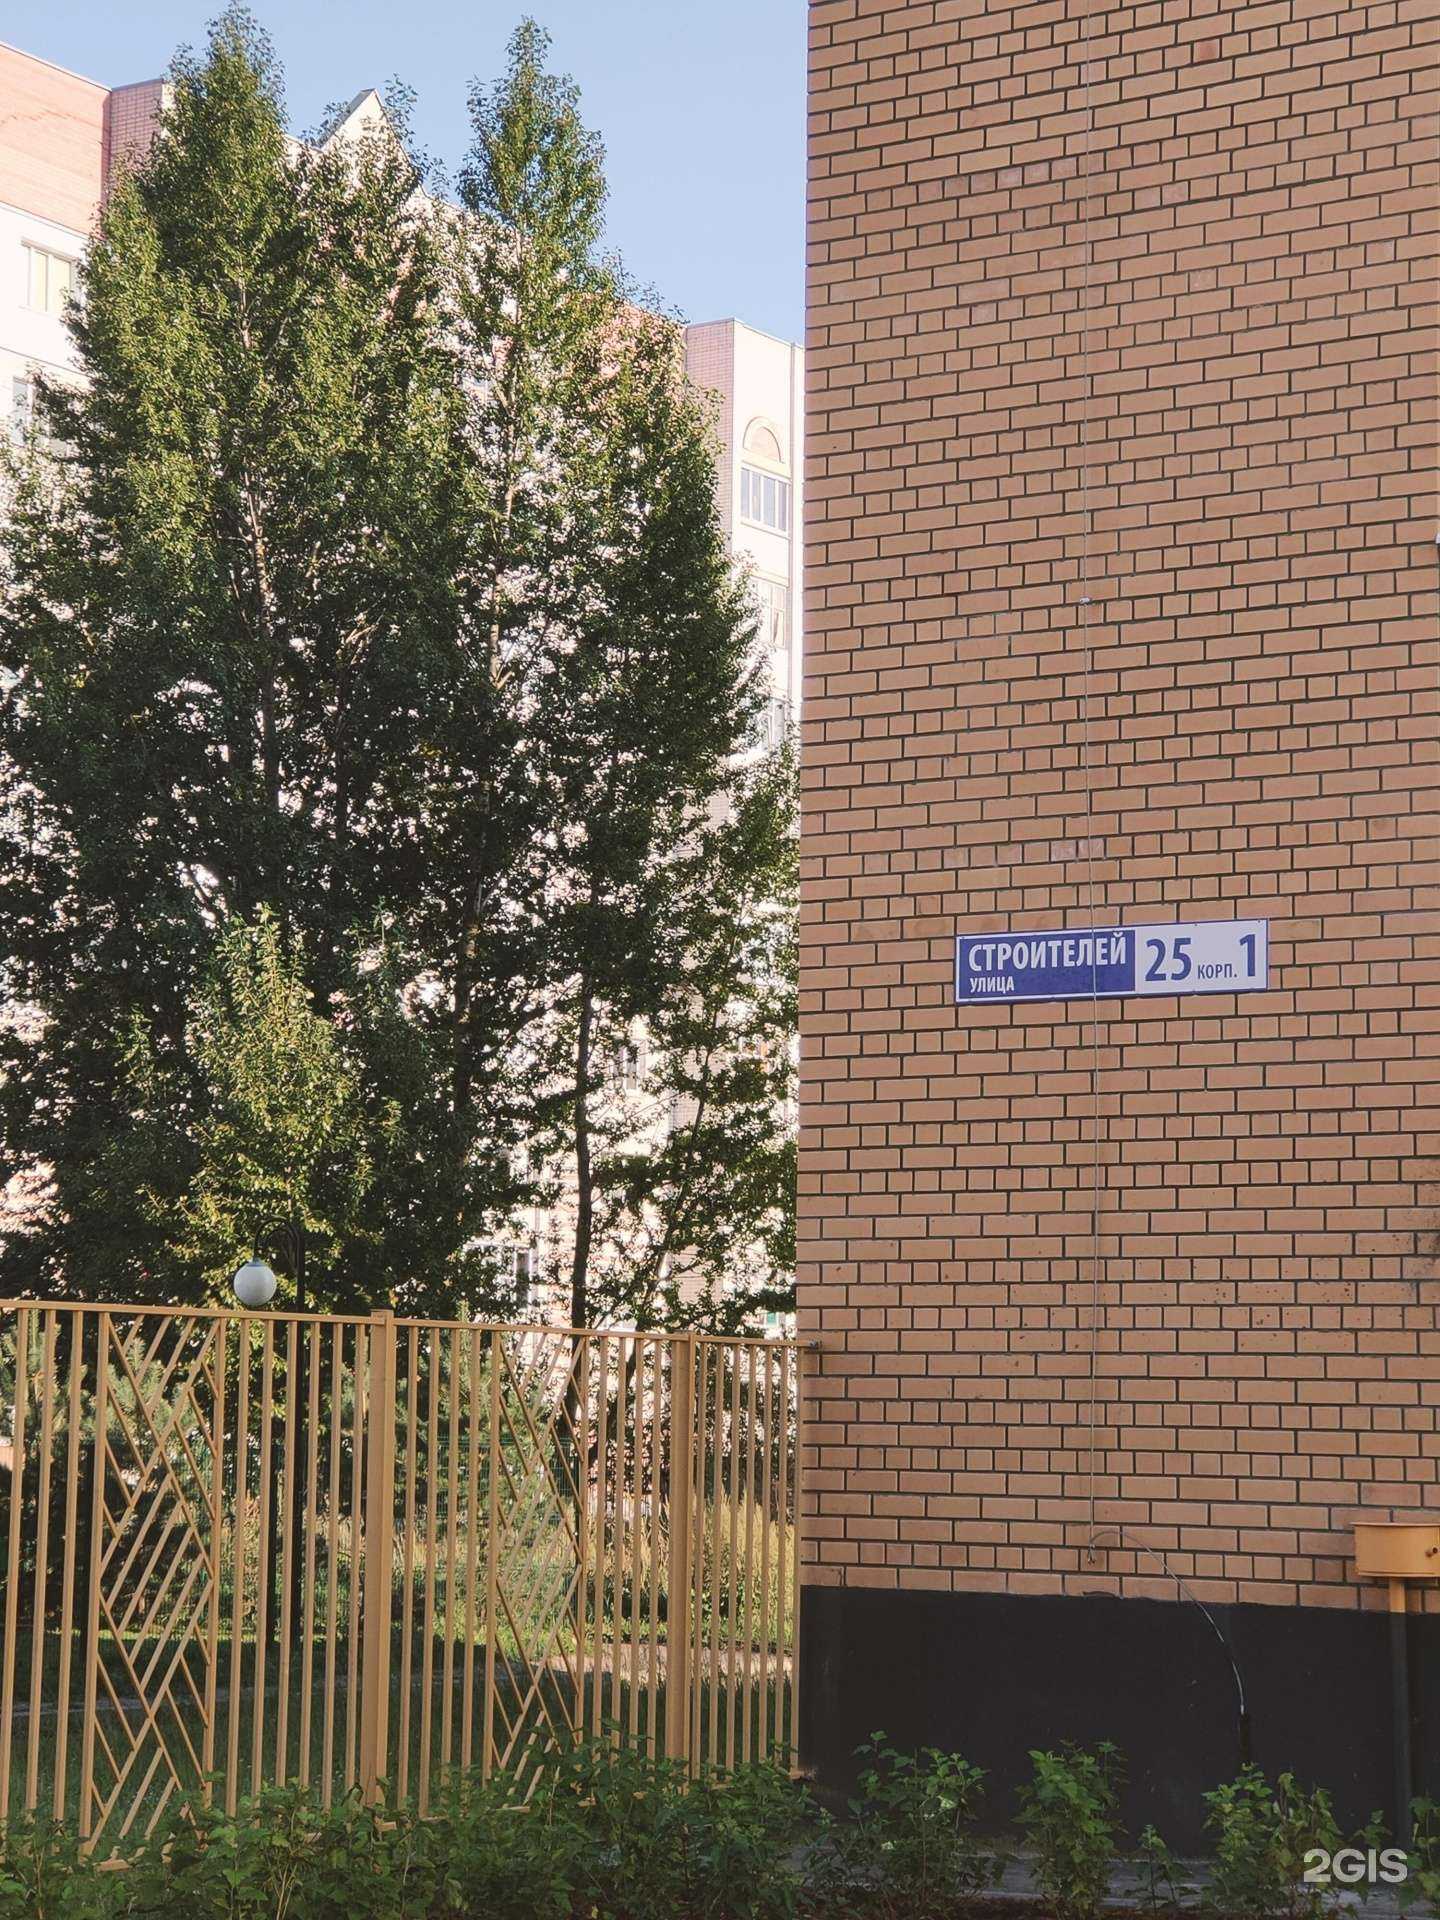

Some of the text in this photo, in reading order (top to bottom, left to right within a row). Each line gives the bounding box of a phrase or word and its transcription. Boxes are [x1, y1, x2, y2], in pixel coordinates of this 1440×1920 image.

[968, 932, 1127, 971] СТРОИТЕЛЕЙ
[1144, 934, 1256, 982] 25 КОРП. 1
[970, 975, 1015, 994] УЛИЦА
